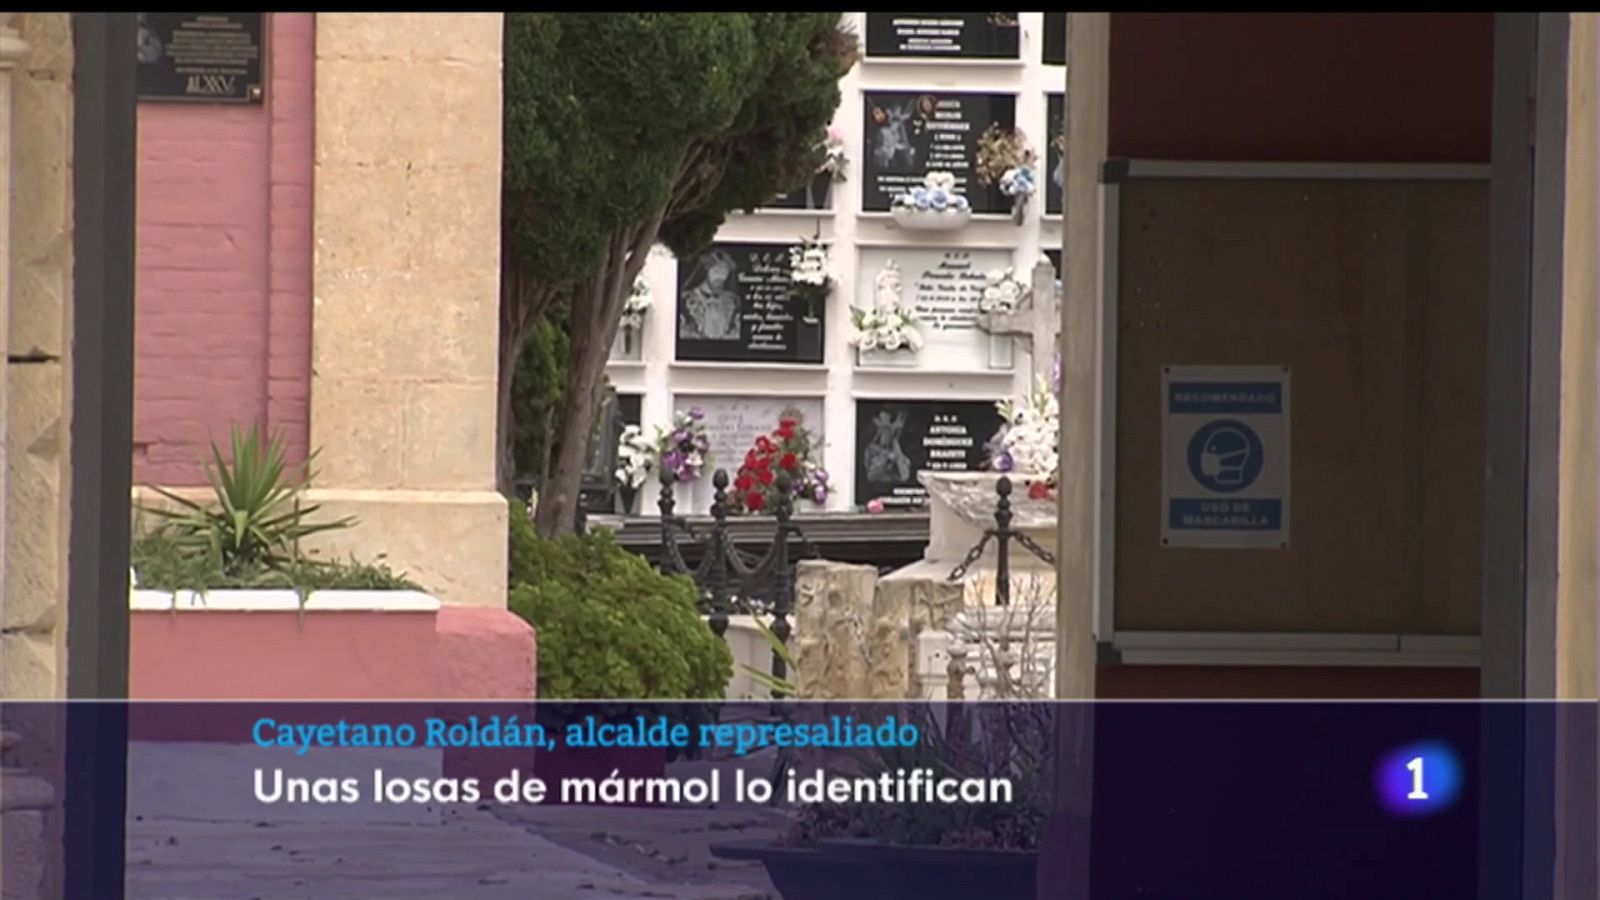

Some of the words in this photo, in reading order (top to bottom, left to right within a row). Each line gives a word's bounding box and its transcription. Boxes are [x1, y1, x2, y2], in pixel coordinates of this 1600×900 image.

[1173, 391, 1277, 403] RECOMENDADO
[1200, 501, 1229, 513] USO
[1232, 501, 1250, 513] DE
[1182, 515, 1269, 527] MASCARILLA
